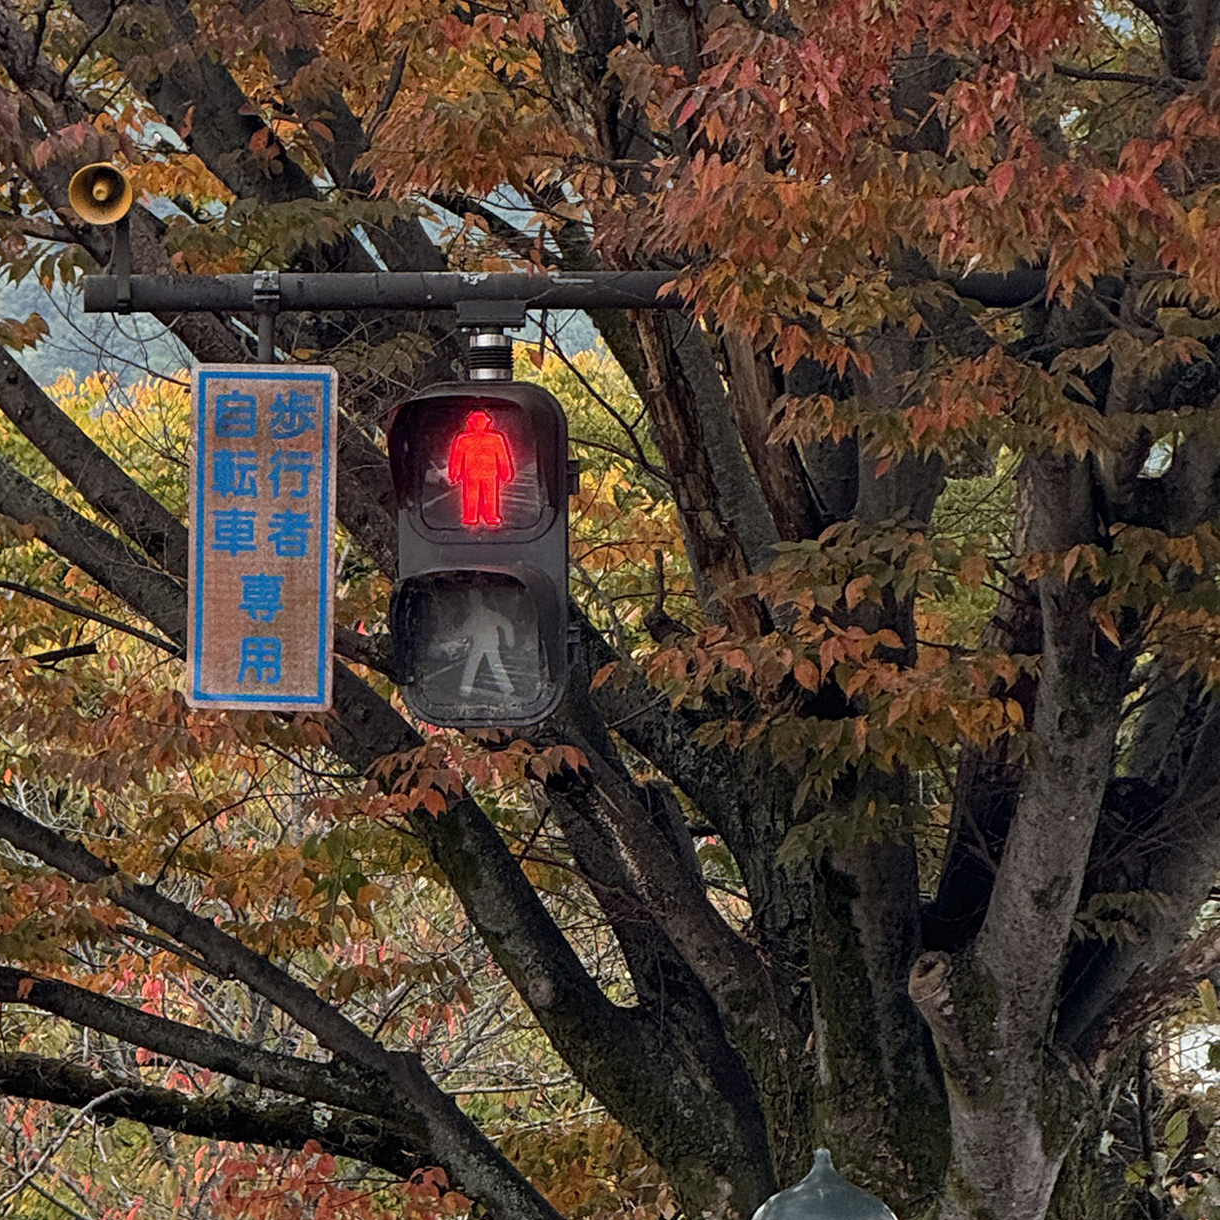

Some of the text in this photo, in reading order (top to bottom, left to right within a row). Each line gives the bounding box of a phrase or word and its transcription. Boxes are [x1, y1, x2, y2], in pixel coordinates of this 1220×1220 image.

[211, 389, 258, 557] 自転車
[267, 389, 316, 558] 歩行者
[237, 572, 285, 685] 専用
